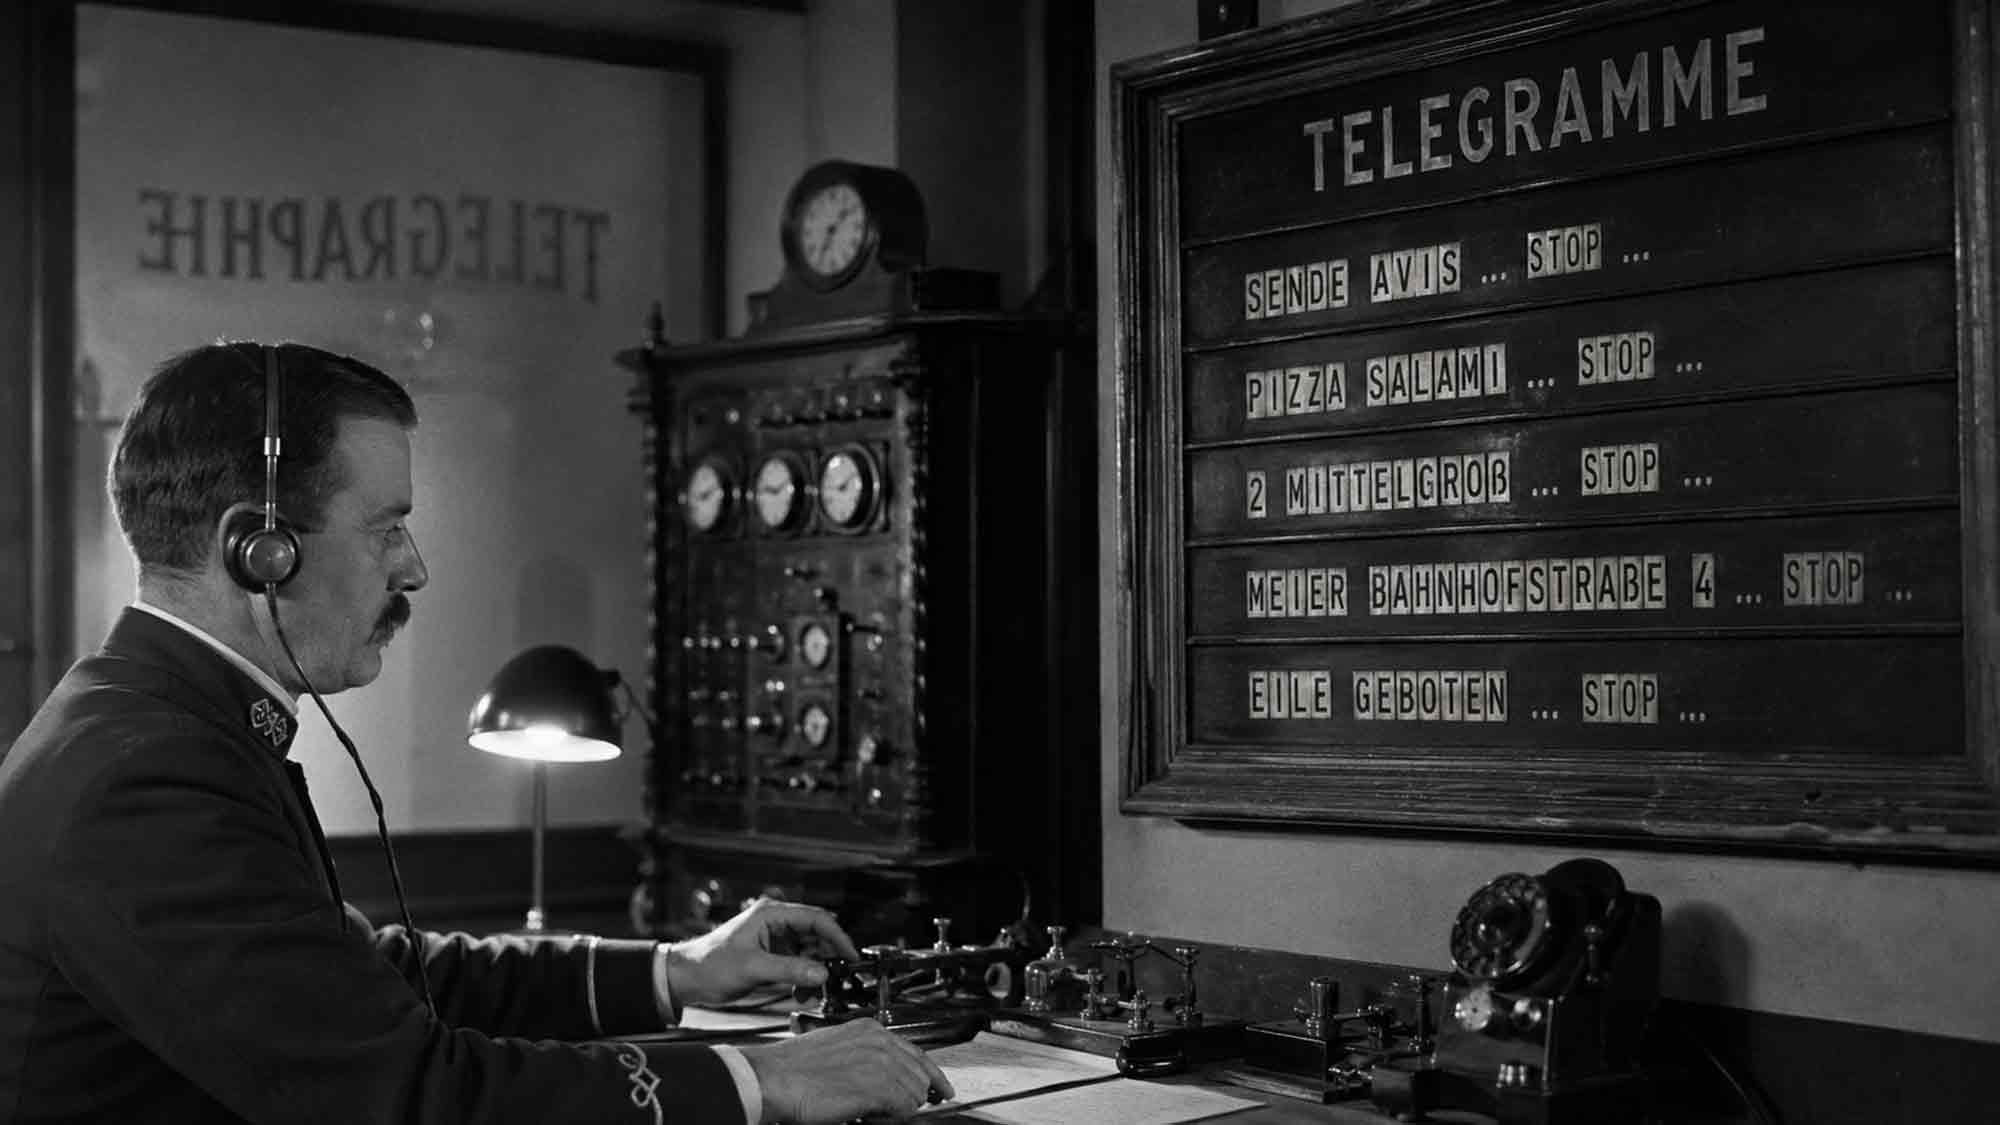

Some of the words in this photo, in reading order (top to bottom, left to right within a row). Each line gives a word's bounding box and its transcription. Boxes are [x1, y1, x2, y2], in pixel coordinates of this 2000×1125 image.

[1303, 27, 1768, 192] TELEGRAMME
[1247, 265, 1345, 313] SENDE
[1373, 249, 1458, 297] AVIS
[1530, 228, 1600, 273] STOP
[1248, 368, 1343, 413] PIZZA
[1369, 349, 1503, 401] SALAMI
[1581, 337, 1652, 379] STOP
[1248, 476, 1264, 514] 2
[1288, 458, 1508, 510] MITTELGROß
[1584, 449, 1657, 490] STOP
[1248, 574, 1345, 612] MEIER
[1372, 561, 1664, 609] BAHNHOFSTRAßE
[1693, 559, 1714, 602] 4
[1786, 557, 1862, 600] STOP
[1251, 677, 1329, 713] EILE
[1355, 677, 1505, 716] GEBOTEN
[1585, 679, 1656, 718] STOP
